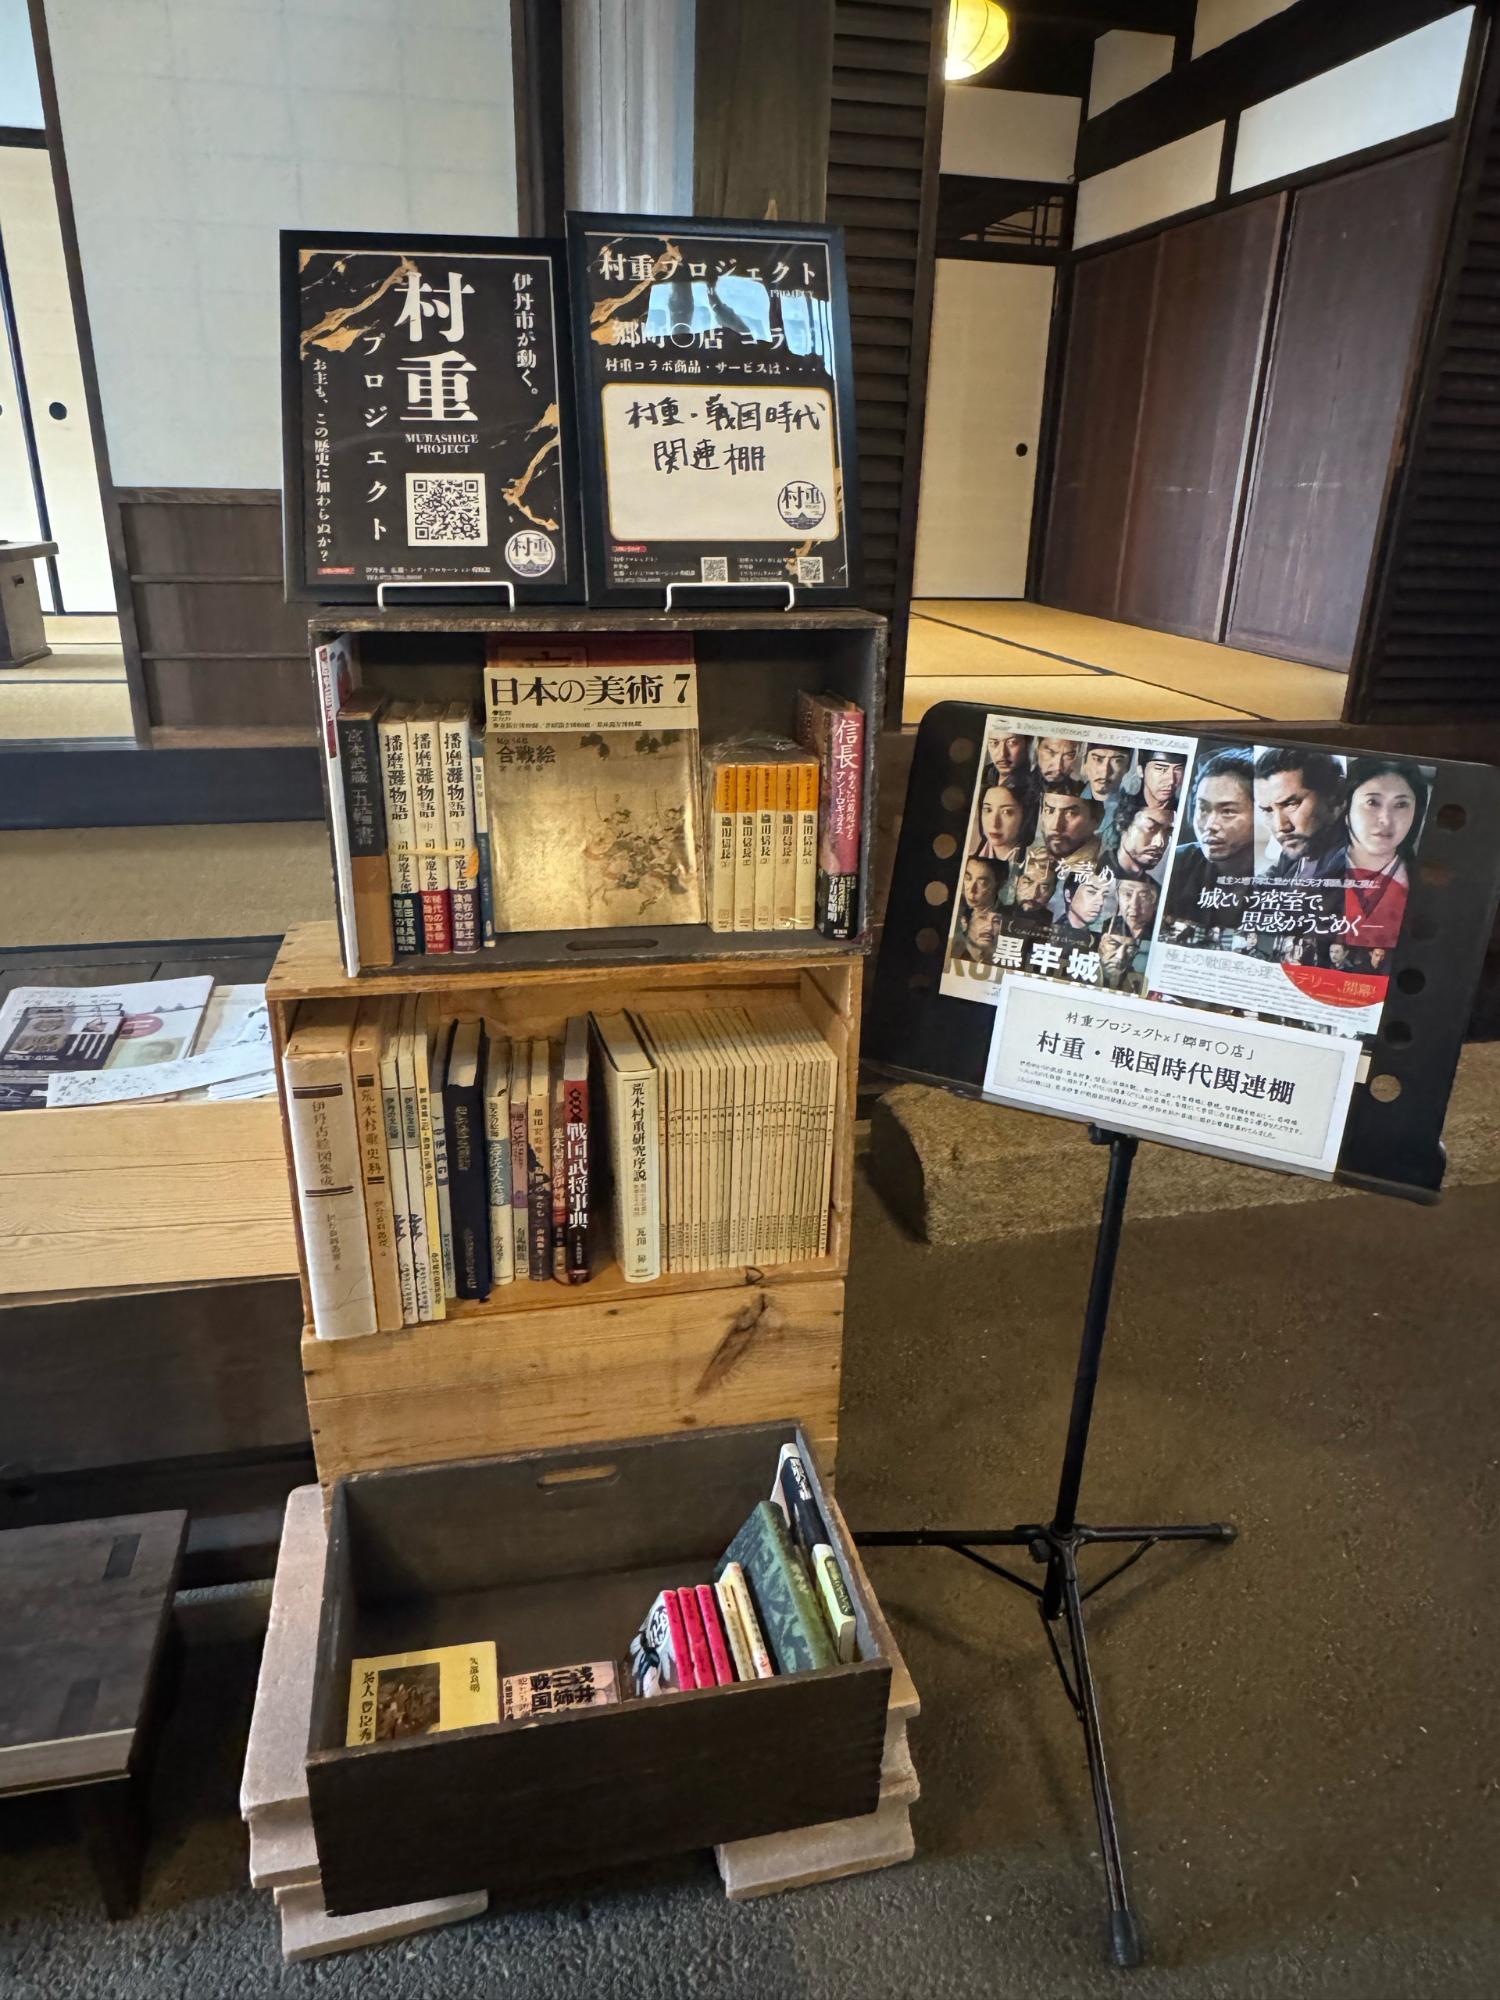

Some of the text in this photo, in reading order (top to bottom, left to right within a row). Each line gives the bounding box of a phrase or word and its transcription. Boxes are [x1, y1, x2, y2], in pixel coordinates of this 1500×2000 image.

[599, 253, 817, 284] 村重プロジェクト
[394, 271, 478, 421] 村重
[513, 272, 539, 395] 伊丹市が動く。
[364, 332, 389, 541] プロジェクト
[404, 433, 479, 444] MURASHIGE
[625, 393, 826, 433] 村重・戦国時代
[416, 444, 470, 454] PROJECT
[653, 438, 765, 476] 関連棚
[491, 673, 691, 706] 日本の美術 7
[345, 729, 369, 784] 宮本武蔵
[497, 745, 556, 764] 合戦絵
[836, 720, 860, 769] 信長
[385, 733, 409, 820] 播磨灘物語
[413, 732, 435, 818] 播磨灘物語
[444, 732, 466, 818] 播磨灘物語
[1196, 887, 1324, 912] 城という密室で、
[992, 934, 1101, 983] 黒牢城
[1036, 1030, 1297, 1105] 村重・戦国時代関連棚
[631, 1082, 647, 1182] 荒木村重研究序説
[567, 1122, 590, 1230] 戦国武将事典
